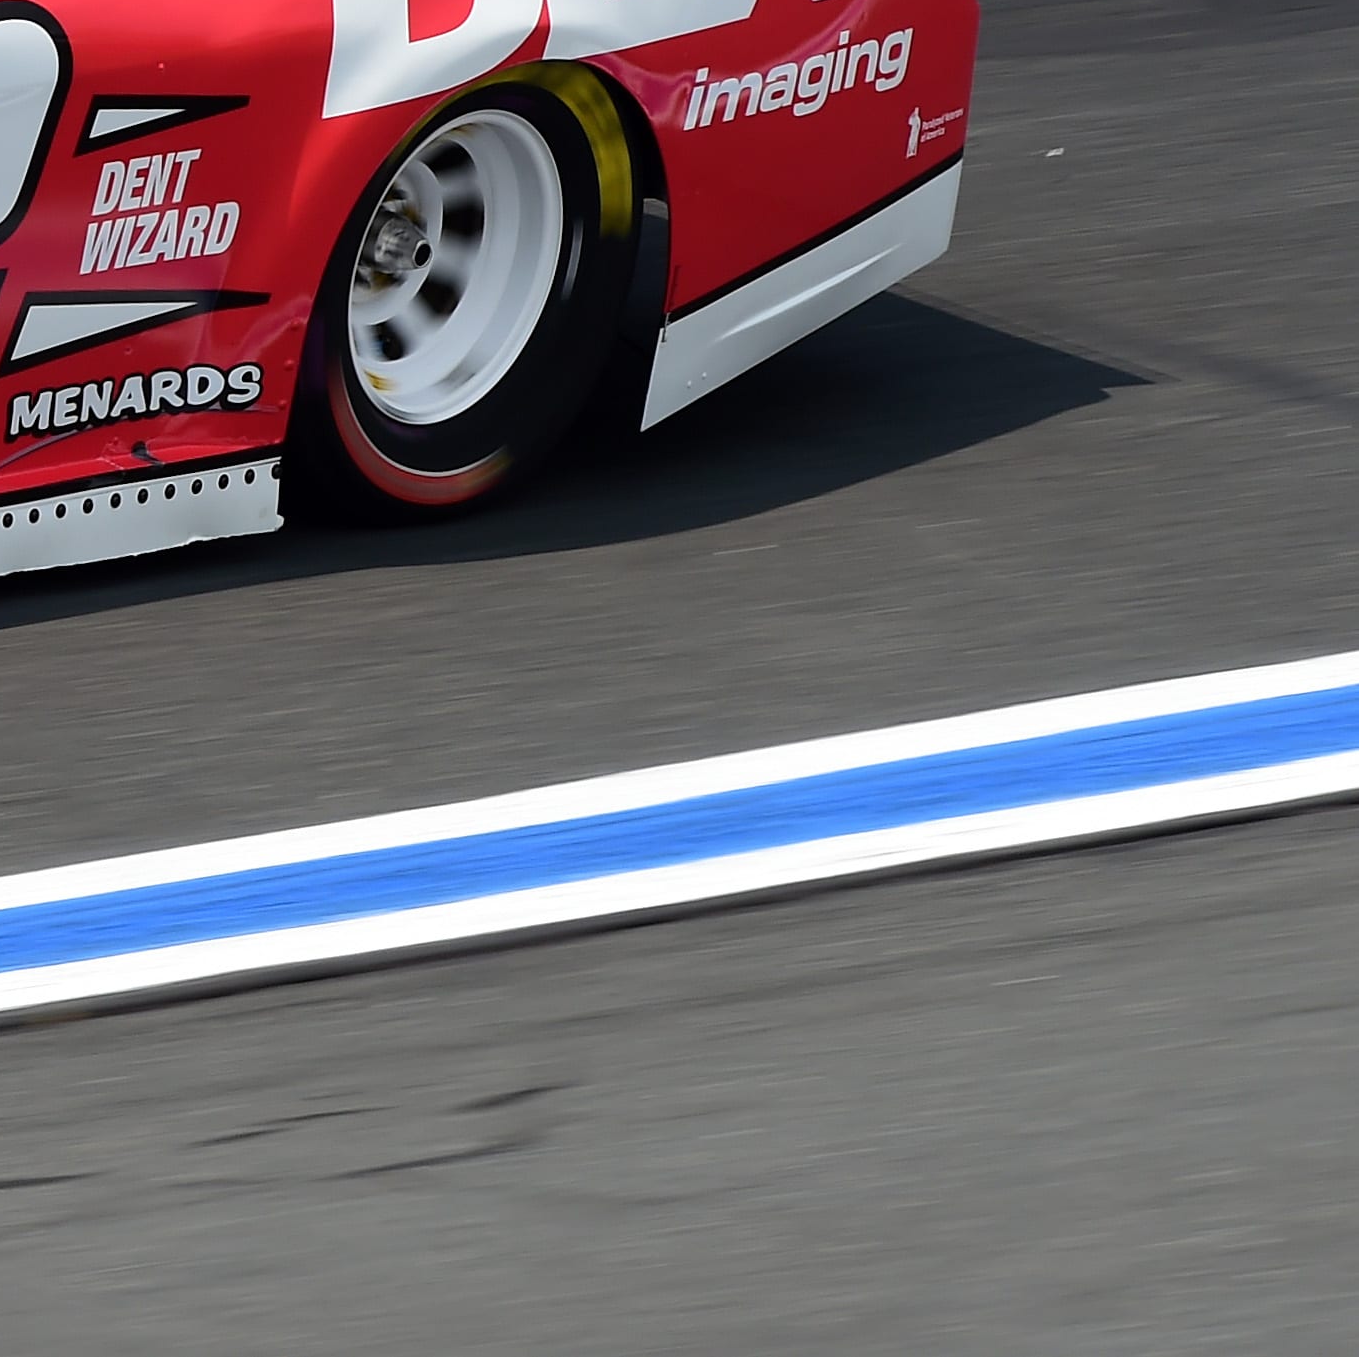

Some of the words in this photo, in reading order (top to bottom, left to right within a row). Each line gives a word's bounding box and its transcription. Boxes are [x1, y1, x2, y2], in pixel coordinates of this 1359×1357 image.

[683, 28, 914, 131] imaging
[92, 148, 203, 217] DENT
[79, 201, 241, 275] WIZARD
[5, 362, 266, 441] MENARDS
